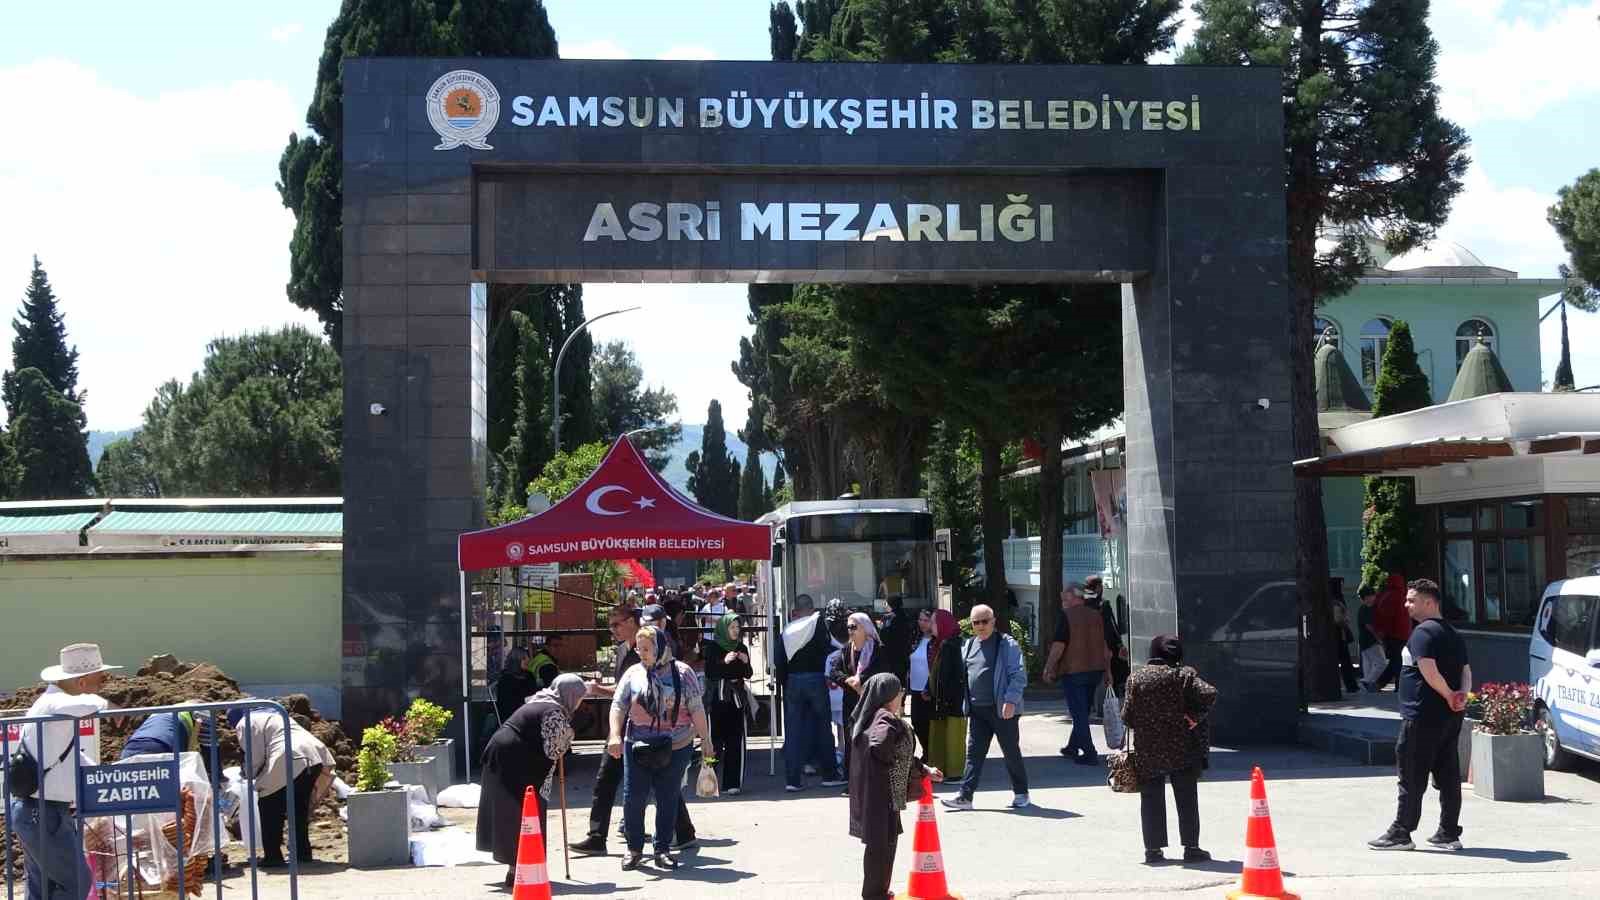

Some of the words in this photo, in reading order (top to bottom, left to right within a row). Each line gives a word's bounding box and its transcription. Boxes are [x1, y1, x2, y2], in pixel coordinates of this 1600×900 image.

[511, 96, 684, 128] SAMSUN
[699, 91, 958, 134] BÜYÜKŞEHİR
[971, 94, 1201, 131] BELEDİYESİ
[583, 200, 721, 241] ASRİ
[740, 193, 1054, 242] MEZARLIĞI
[528, 542, 579, 555] SAMSUN
[581, 537, 657, 551] BÜYÜKŞEHİR
[659, 537, 725, 549] BELEDİYESİ
[86, 766, 170, 785] BÜYÜKŞEHİR
[97, 785, 160, 803] ZABITA
